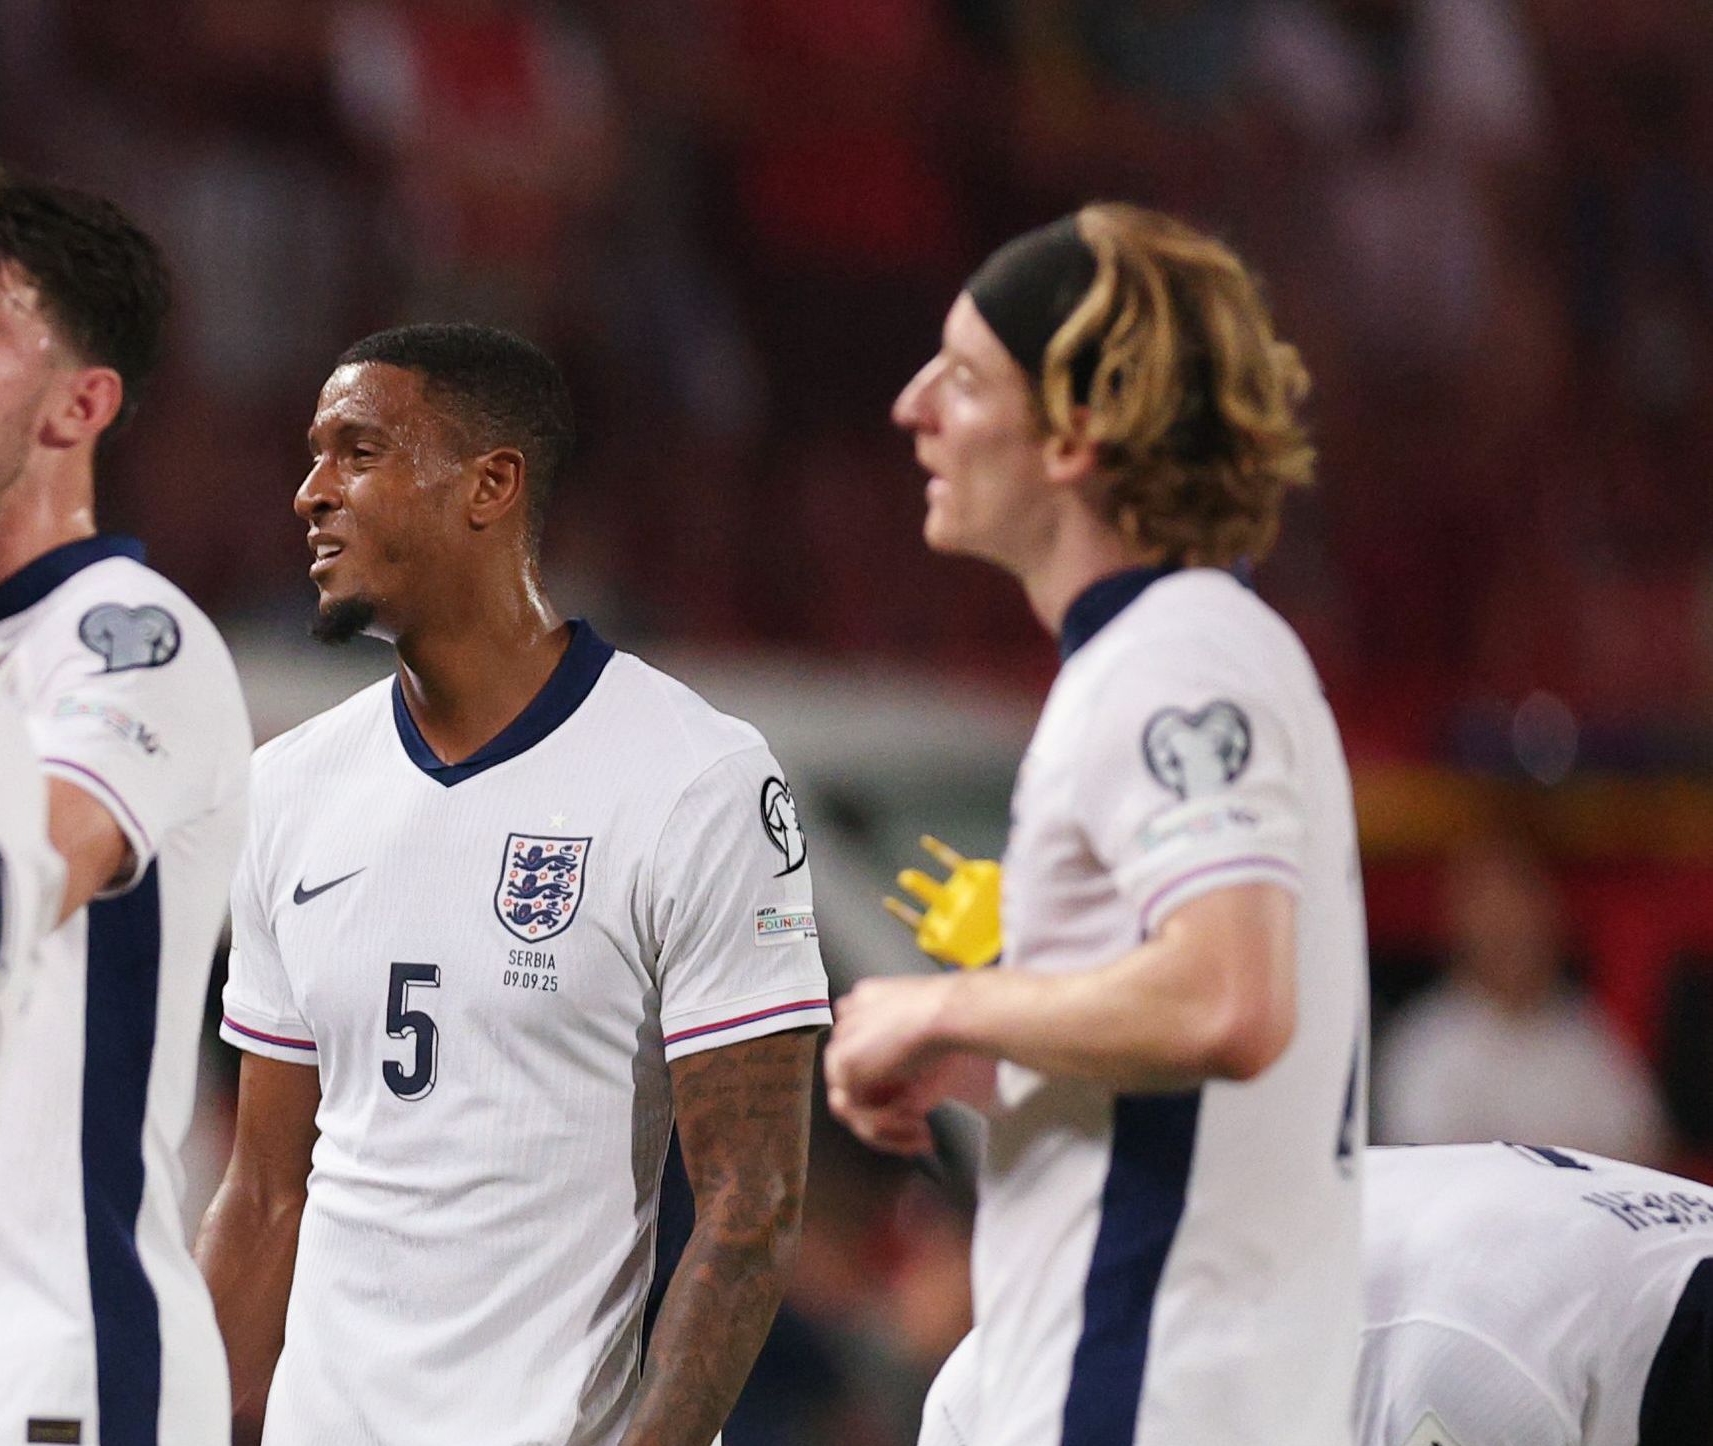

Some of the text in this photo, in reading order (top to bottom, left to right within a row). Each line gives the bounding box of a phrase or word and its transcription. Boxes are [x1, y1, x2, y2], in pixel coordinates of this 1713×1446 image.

[508, 949, 556, 970] SERBIA
[503, 970, 558, 992] 09.09.25
[382, 962, 441, 1102] 5
